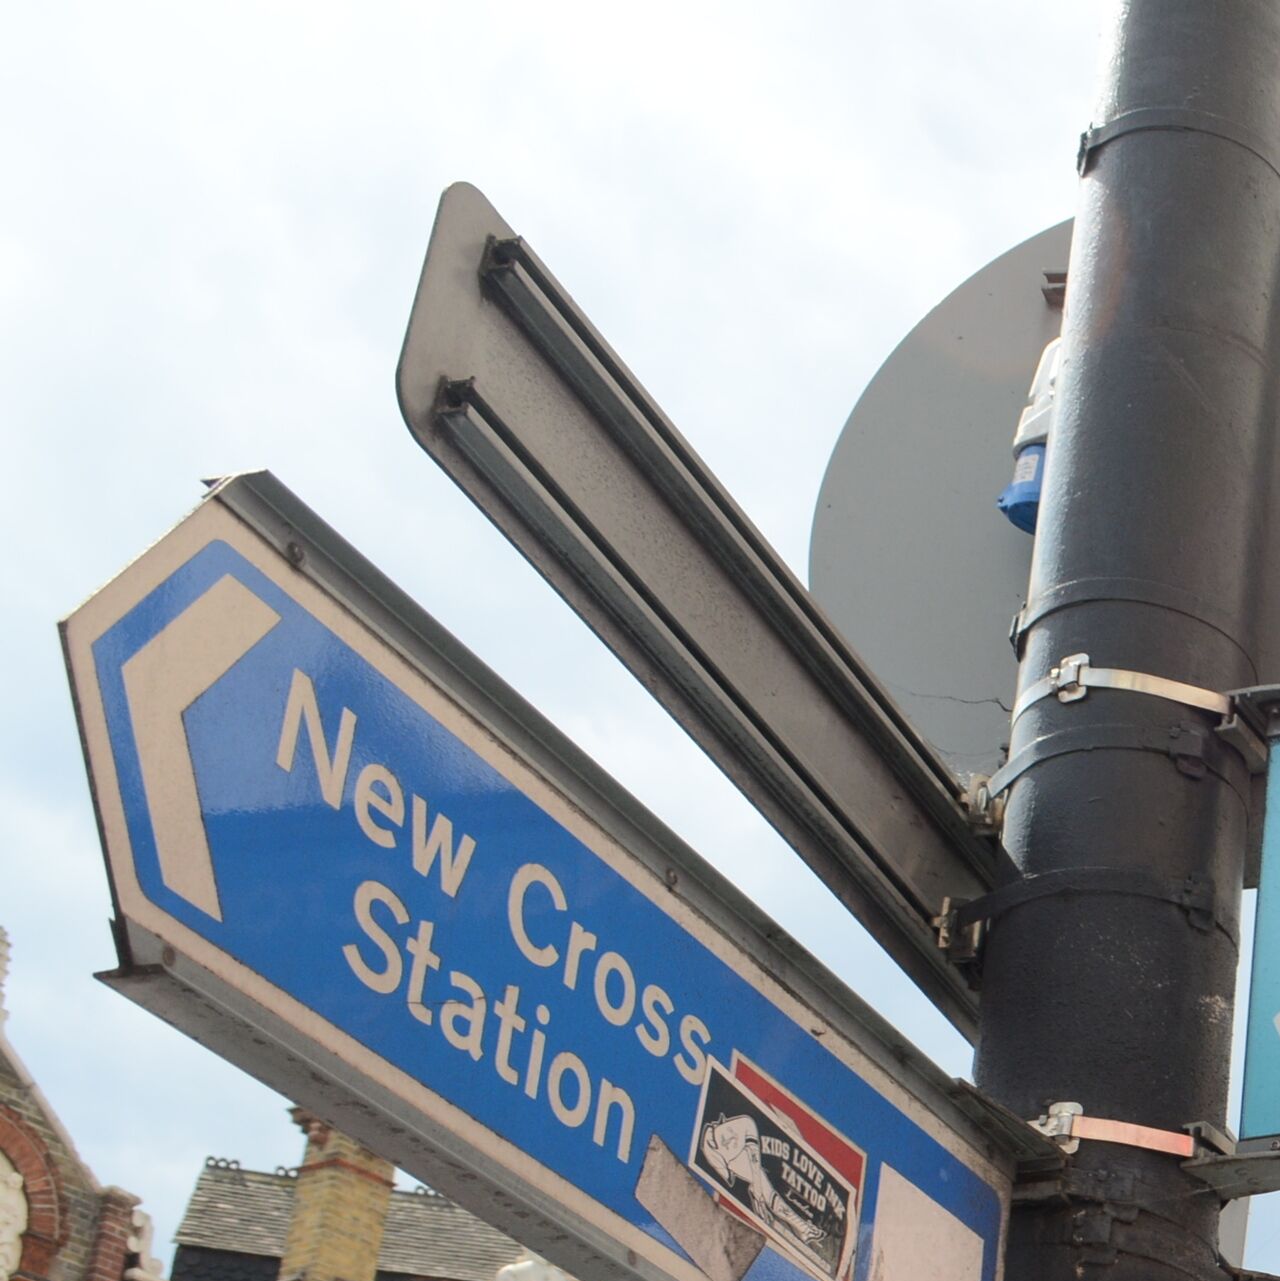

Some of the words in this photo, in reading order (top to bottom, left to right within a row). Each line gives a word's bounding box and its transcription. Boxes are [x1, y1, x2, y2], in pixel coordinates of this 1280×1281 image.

[275, 667, 477, 898] New
[507, 862, 711, 1086] Cross
[342, 879, 635, 1164] Station
[760, 1135, 790, 1160] KIDS
[793, 1149, 824, 1189] LOVE
[781, 1162, 827, 1213] TATTOO
